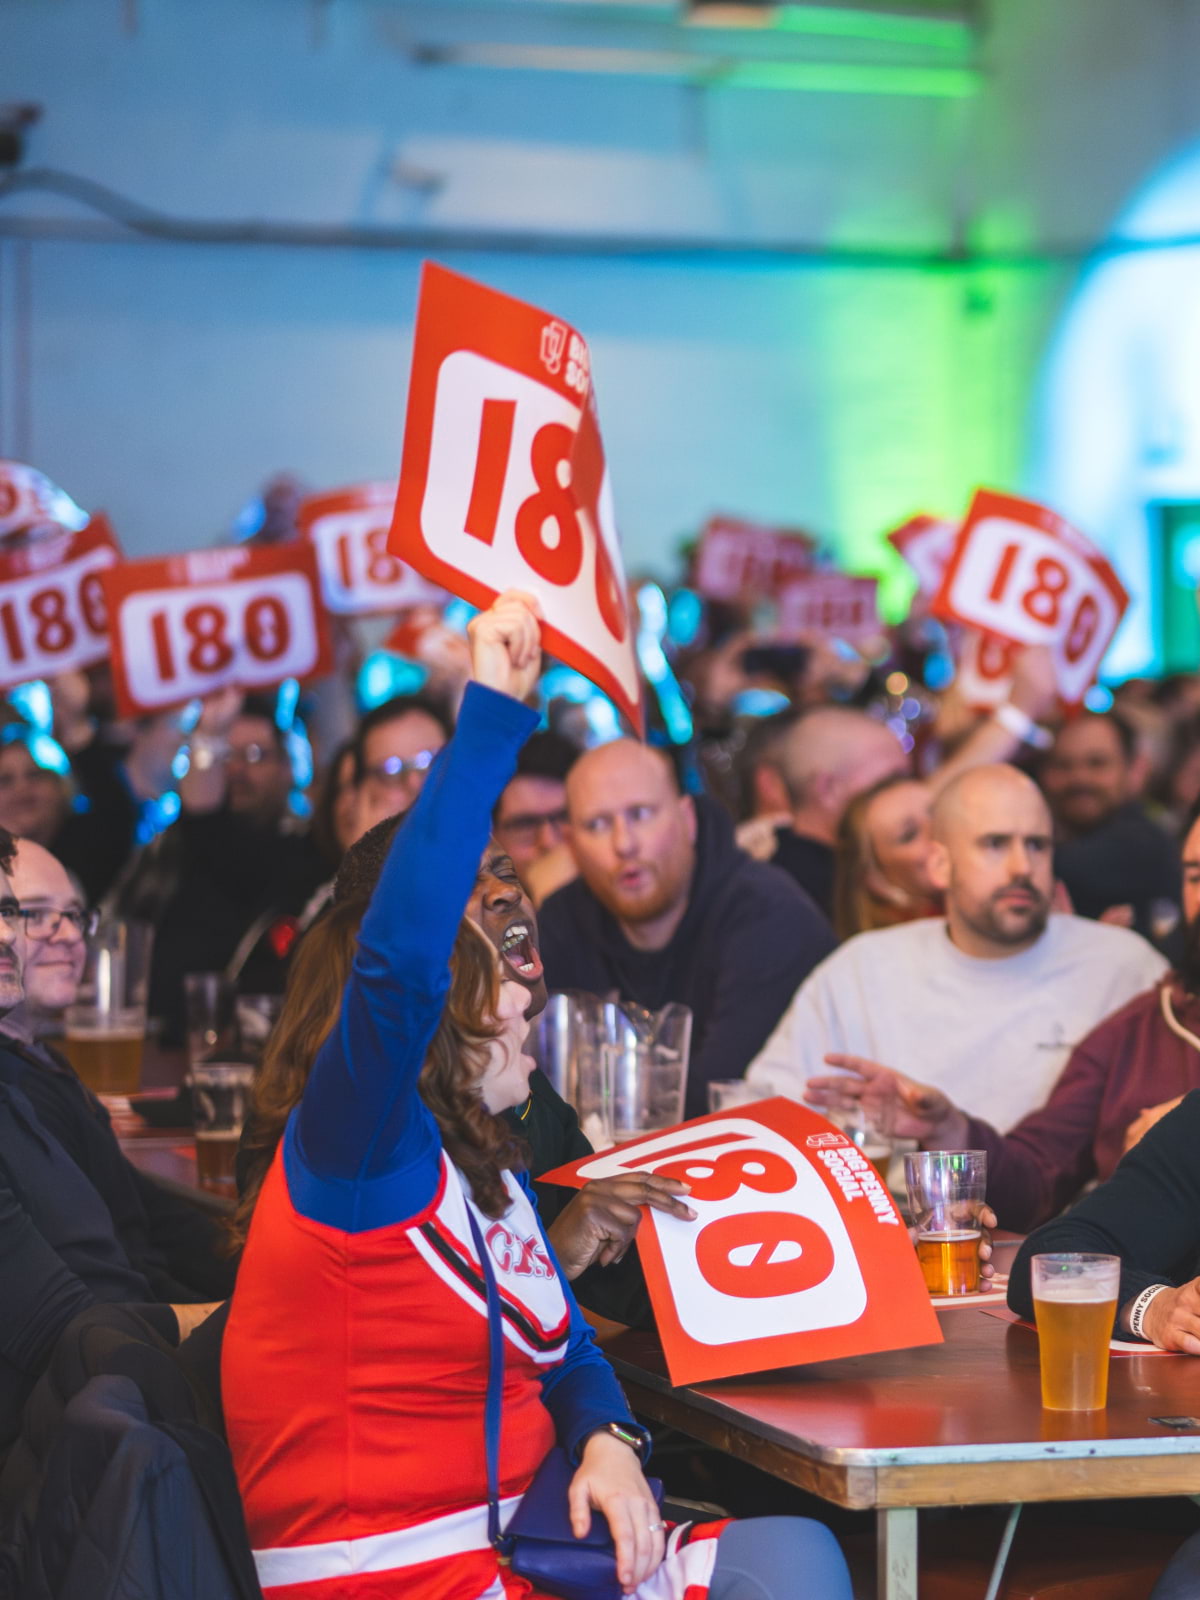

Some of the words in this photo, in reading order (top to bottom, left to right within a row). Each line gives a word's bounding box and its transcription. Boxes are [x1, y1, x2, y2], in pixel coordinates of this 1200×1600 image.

[335, 525, 393, 590] 18
[148, 595, 292, 683] 180
[989, 543, 1099, 665] 180
[617, 1131, 835, 1299] 180
[816, 1149, 864, 1203] SOCIAL
[837, 1147, 868, 1171] BIG
[854, 1170, 900, 1226] PENNY
[1132, 1303, 1144, 1334] PENNY
